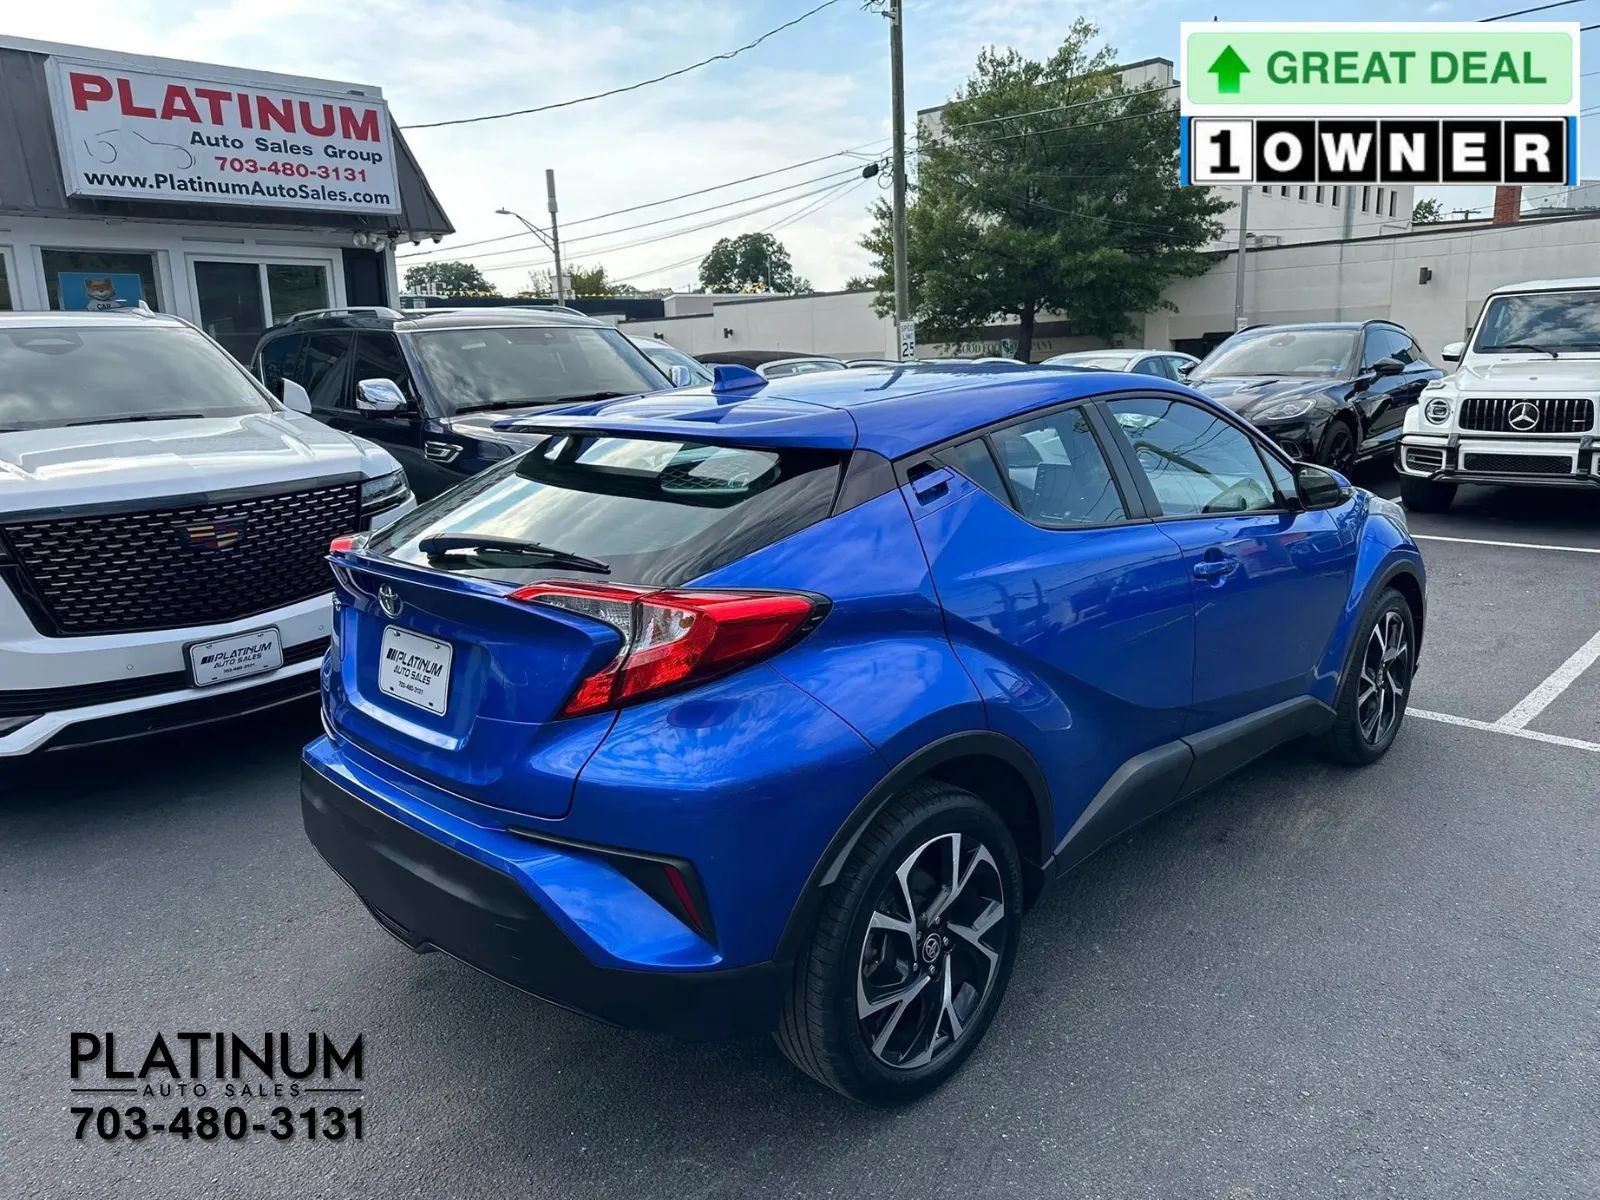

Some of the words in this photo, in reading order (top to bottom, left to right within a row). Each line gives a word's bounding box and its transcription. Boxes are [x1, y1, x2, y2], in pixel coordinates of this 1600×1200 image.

[69, 71, 381, 143] PLATINUM
[190, 131, 244, 150] Auto
[255, 137, 313, 156] Sales
[324, 144, 383, 165] Group
[214, 156, 367, 182] 703-480-3131
[84, 172, 390, 205] www.PlatinumAutoSales.com
[902, 341, 915, 358] 25
[213, 659, 235, 669] AUTO
[237, 652, 262, 664] SALES
[214, 641, 272, 662] PLATINUM
[395, 650, 443, 678] PLATINUM
[393, 664, 411, 678] AUTO
[410, 670, 432, 686] SALES
